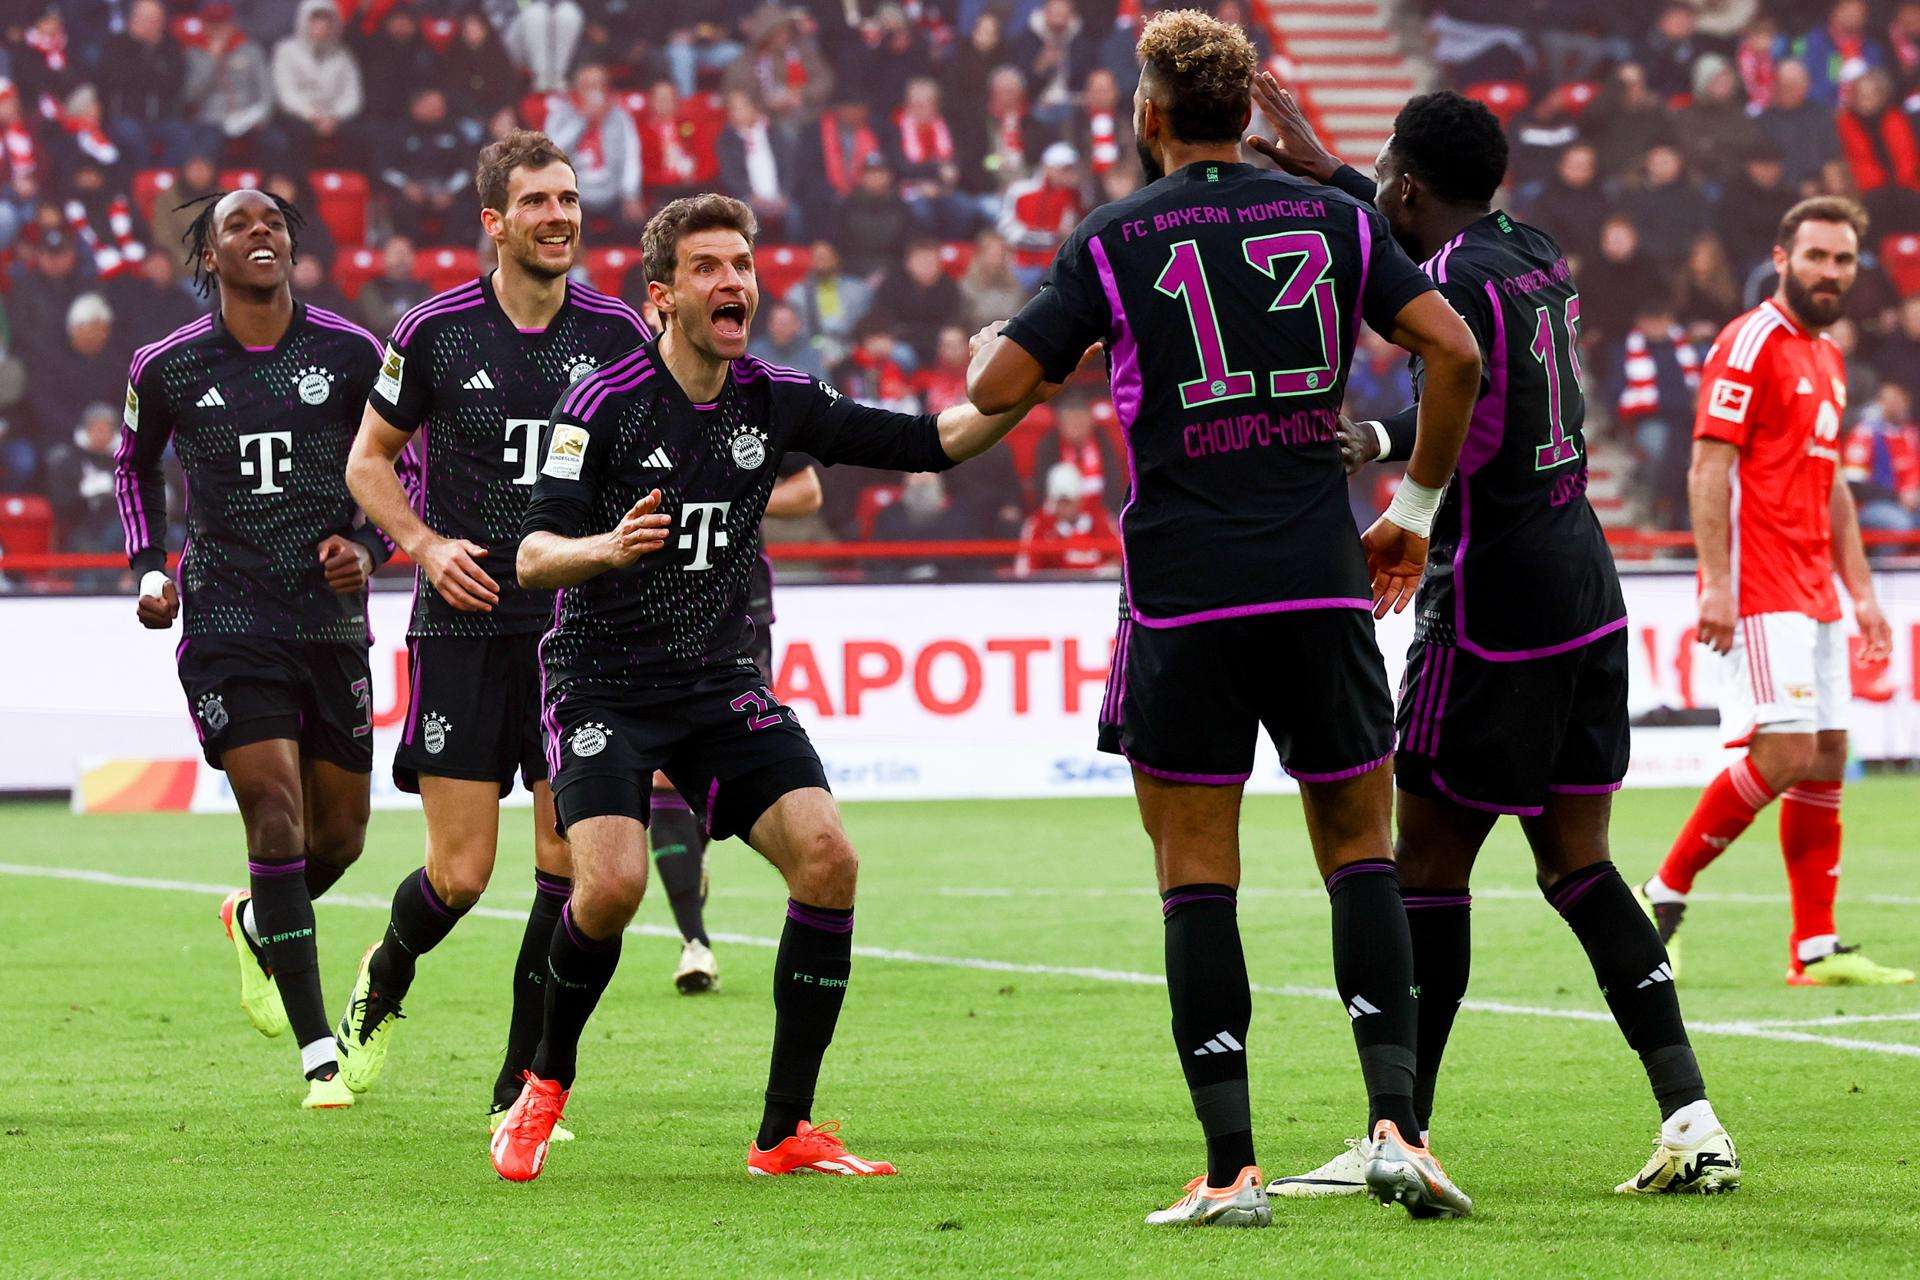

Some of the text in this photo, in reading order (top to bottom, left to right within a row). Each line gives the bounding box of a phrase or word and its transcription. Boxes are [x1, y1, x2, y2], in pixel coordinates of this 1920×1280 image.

[1122, 200, 1326, 242] FC BAYERN MÜNCHEN
[1154, 230, 1341, 409] 13
[239, 431, 292, 494] T
[503, 419, 549, 485] T
[678, 502, 731, 571] T
[794, 972, 813, 983] FC
